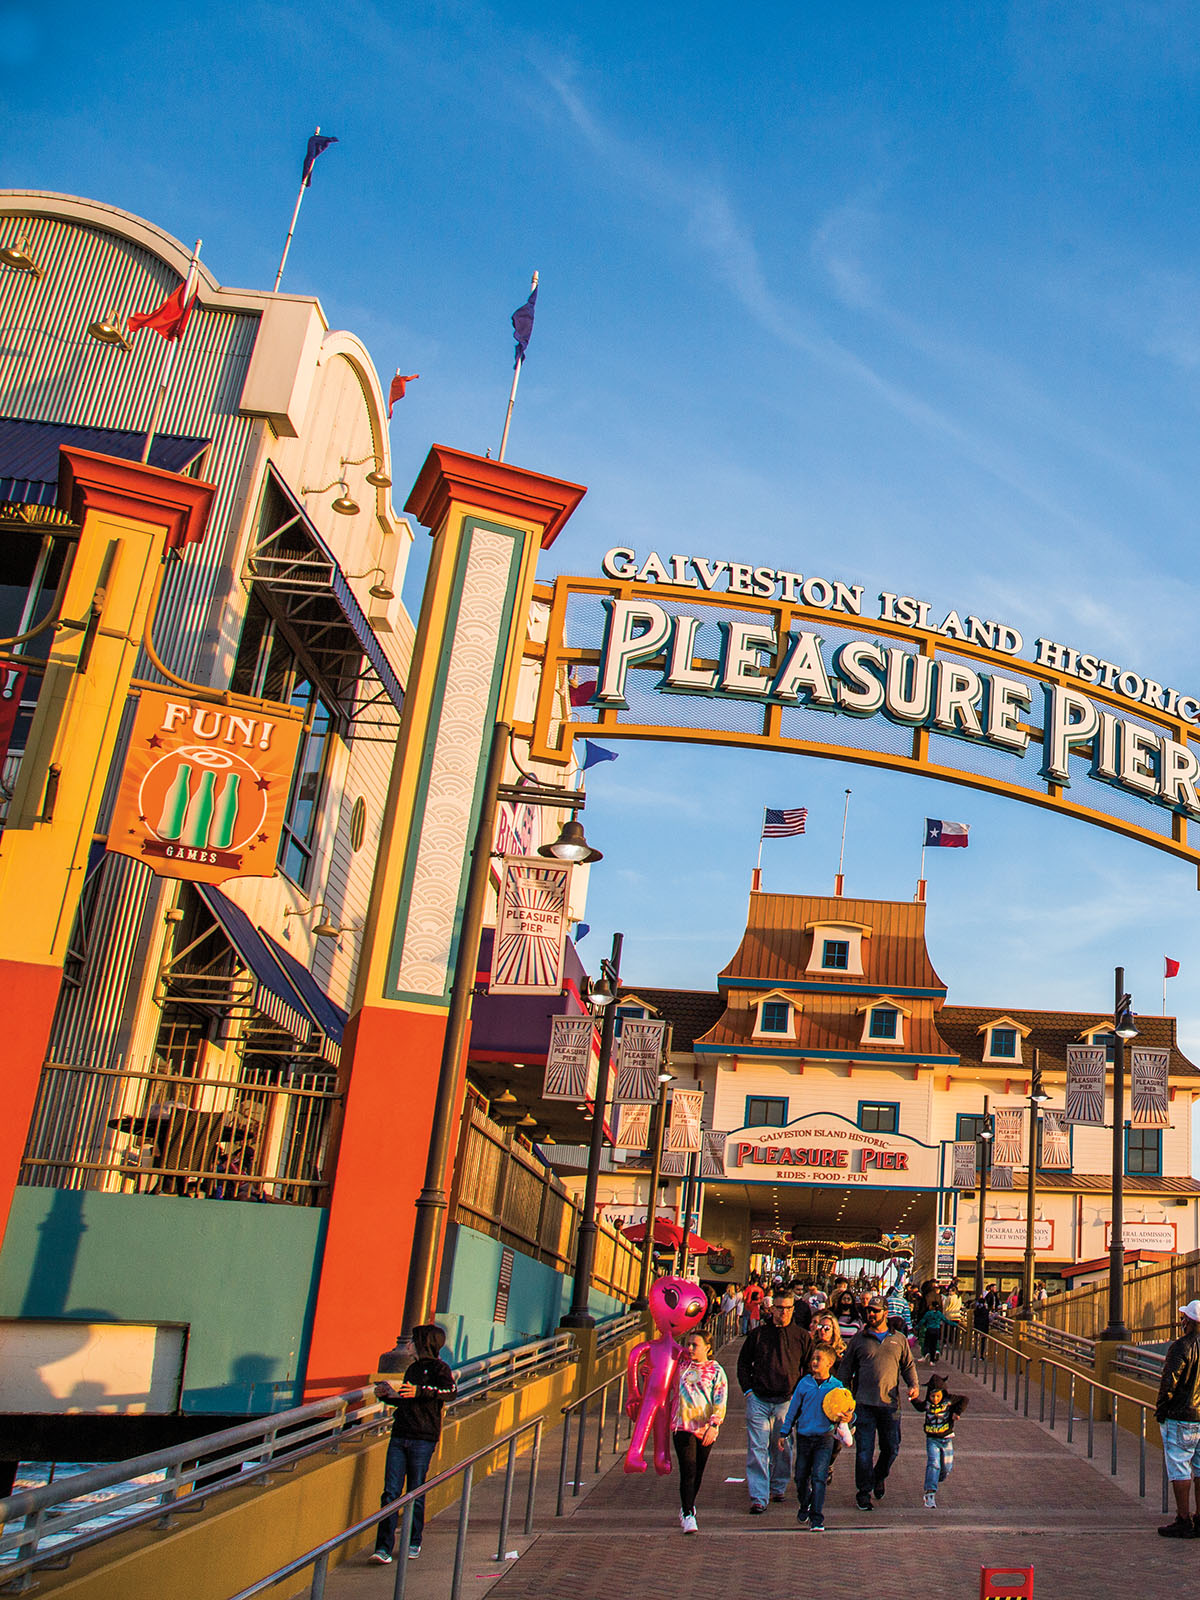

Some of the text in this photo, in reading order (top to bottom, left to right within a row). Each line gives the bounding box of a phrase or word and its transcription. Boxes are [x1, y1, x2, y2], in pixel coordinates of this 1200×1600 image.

[602, 546, 1200, 724] GALVESTON ISLAND HISTORIC
[594, 599, 1032, 757] PLEASURE
[161, 702, 275, 750] FUN!
[166, 845, 218, 864] GAMES
[506, 910, 560, 925] PLEASURE
[520, 922, 543, 933] PIER
[554, 1048, 587, 1056] PLEASURE
[624, 1052, 656, 1060] PLEASURE
[1135, 1078, 1164, 1086] PLEASURE
[760, 1130, 888, 1149] GALVESTON ISLAND HISTORIC
[737, 1142, 909, 1172] PLEASURE PIER
[776, 1171, 868, 1182] RIDES FOOD FUN
